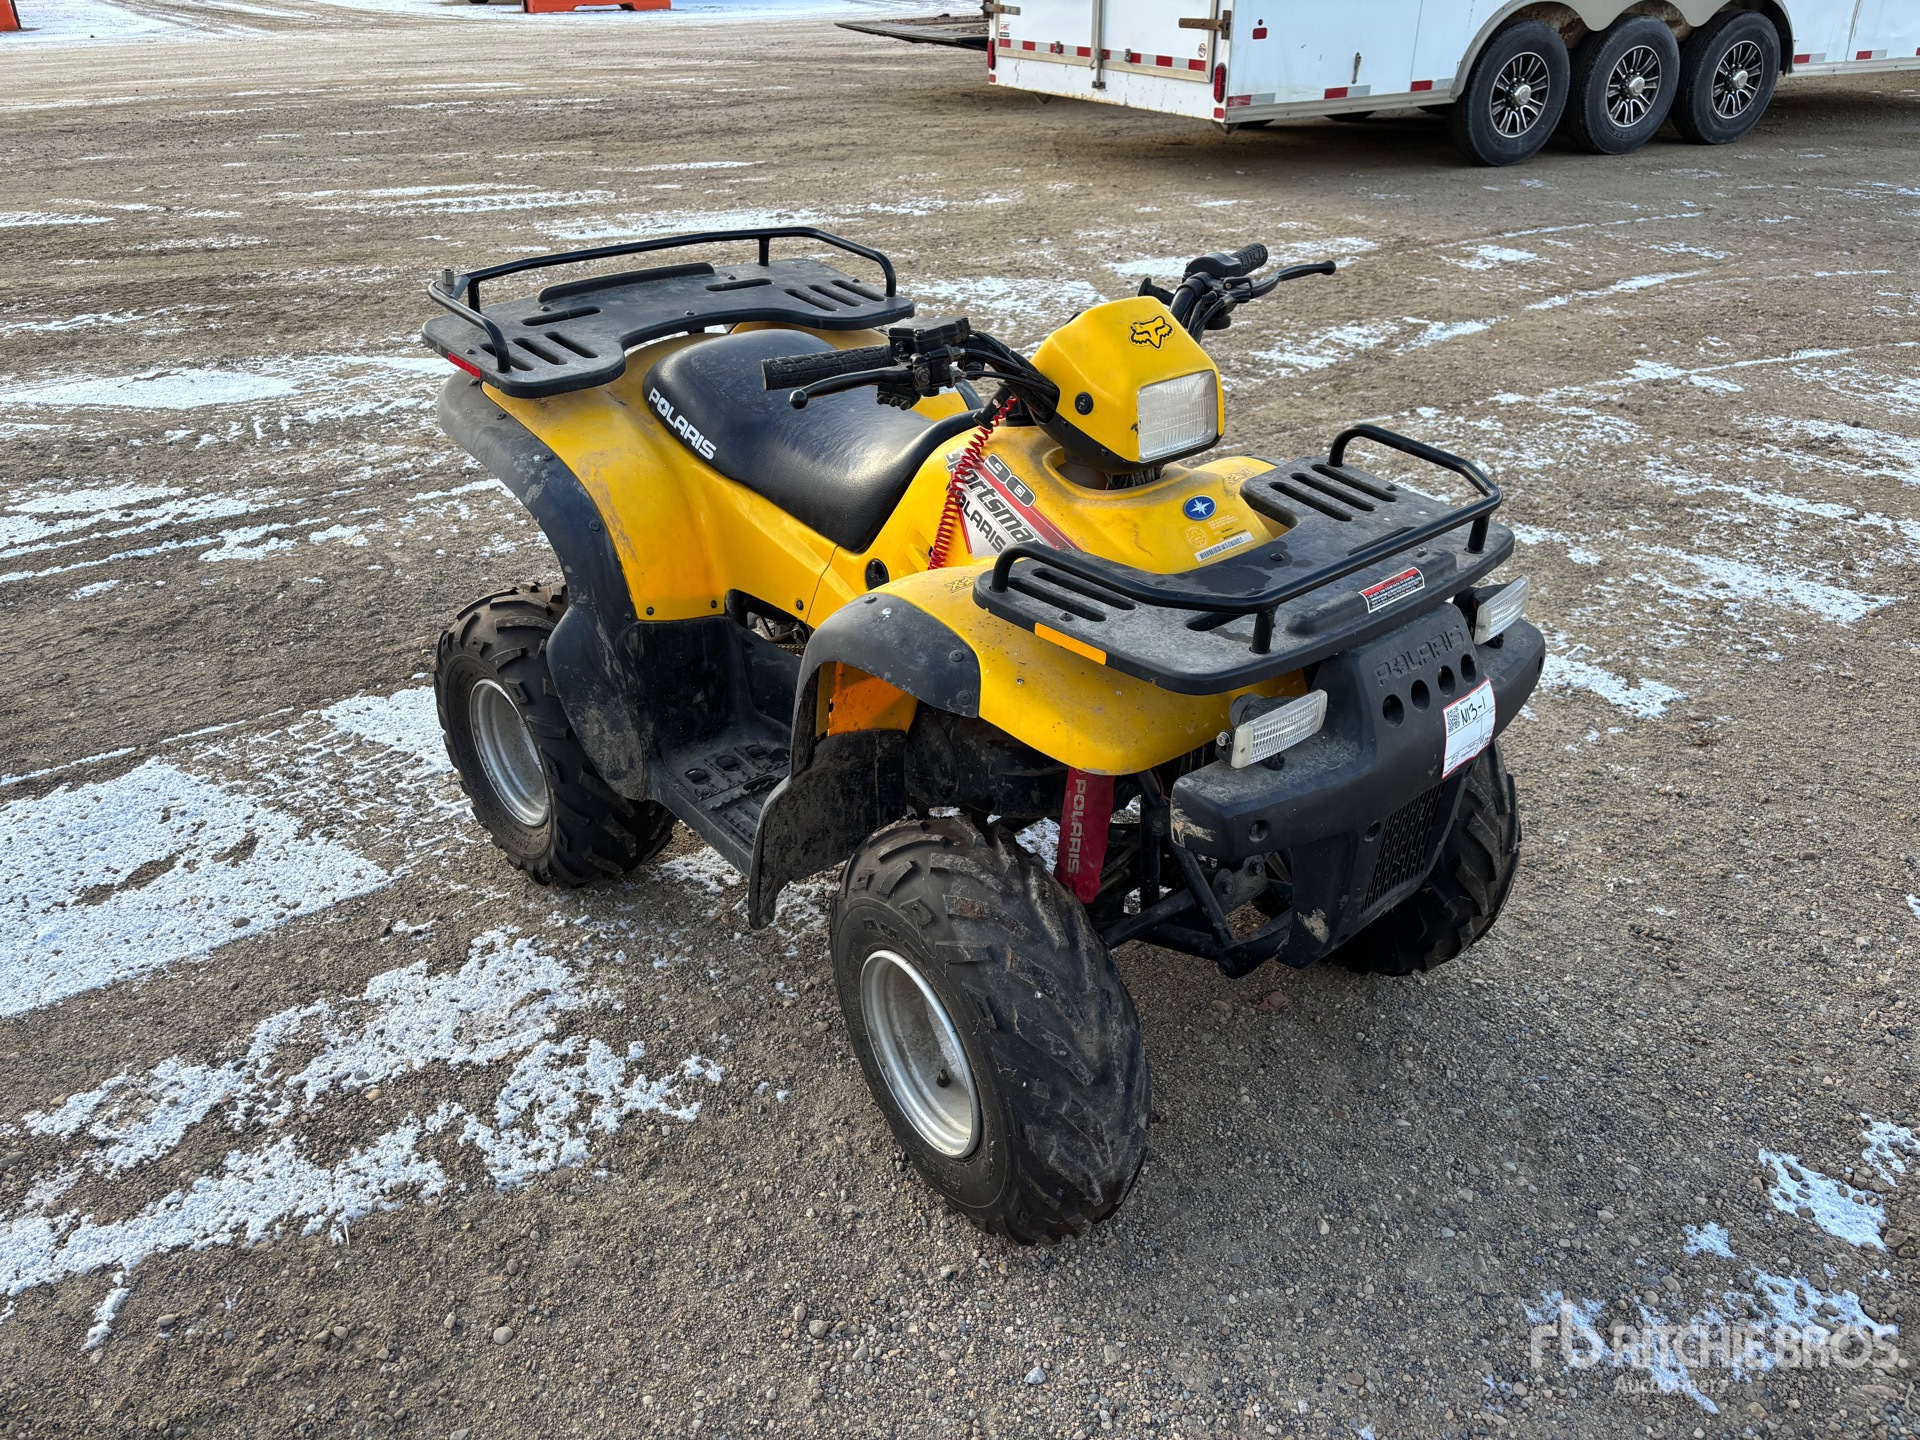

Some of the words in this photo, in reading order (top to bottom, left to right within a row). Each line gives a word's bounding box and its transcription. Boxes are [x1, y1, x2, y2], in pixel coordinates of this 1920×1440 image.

[648, 387, 717, 460] POLARIS
[984, 453, 1036, 507] 90
[946, 482, 1006, 553] OLARIS
[1374, 626, 1464, 686] POLARIS
[1067, 779, 1087, 874] POLARIS
